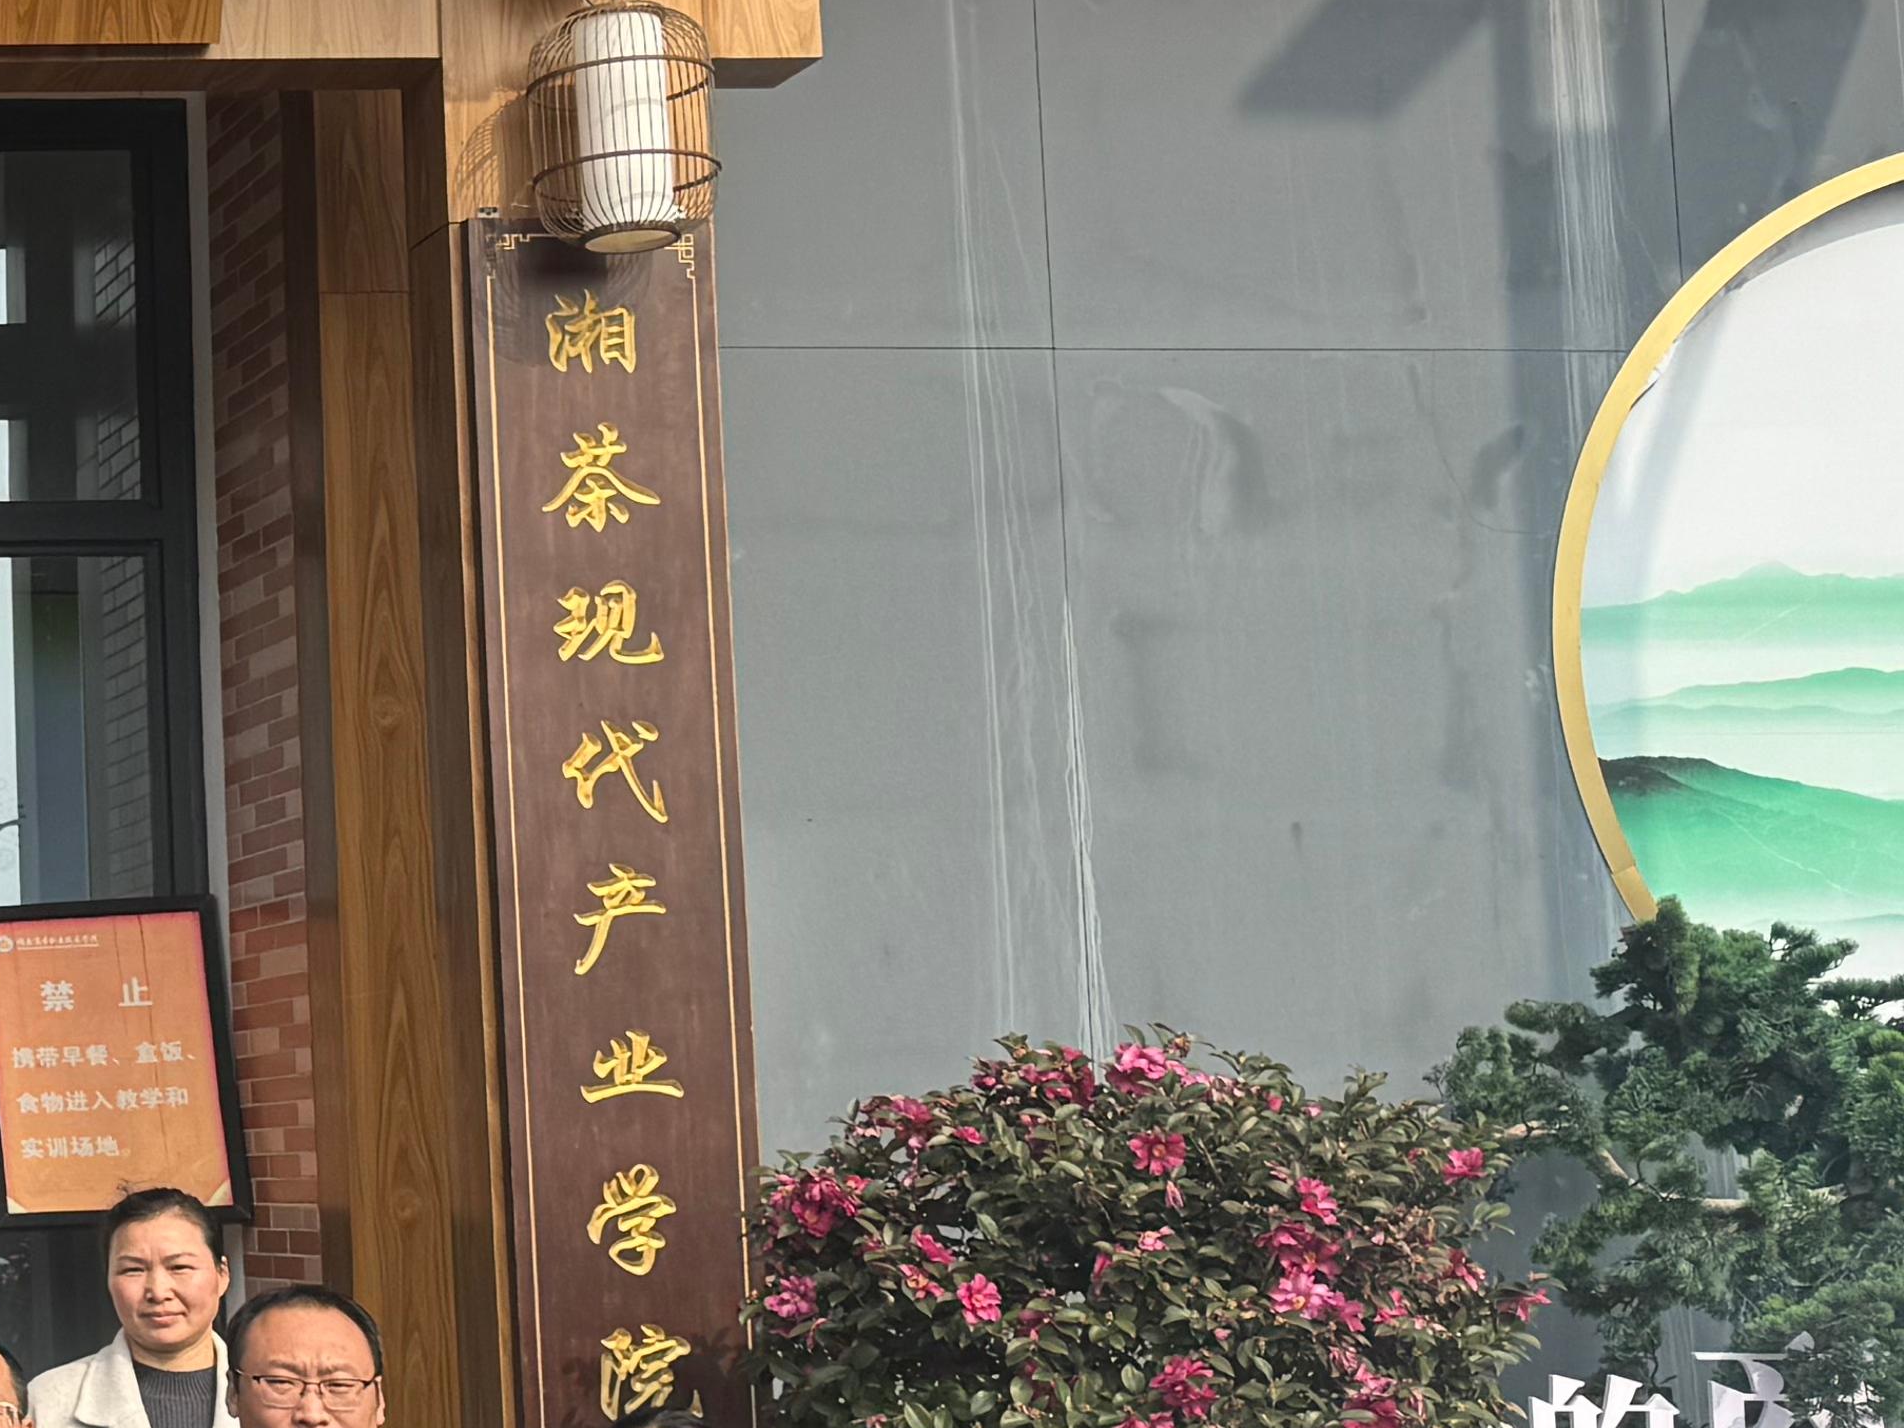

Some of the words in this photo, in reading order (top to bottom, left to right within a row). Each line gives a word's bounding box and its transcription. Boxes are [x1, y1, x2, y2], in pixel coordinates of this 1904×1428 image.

[542, 289, 704, 1422] 湘茶现代产业学院
[40, 977, 153, 1012] 禁止
[16, 1085, 190, 1115] 食物进入教学和
